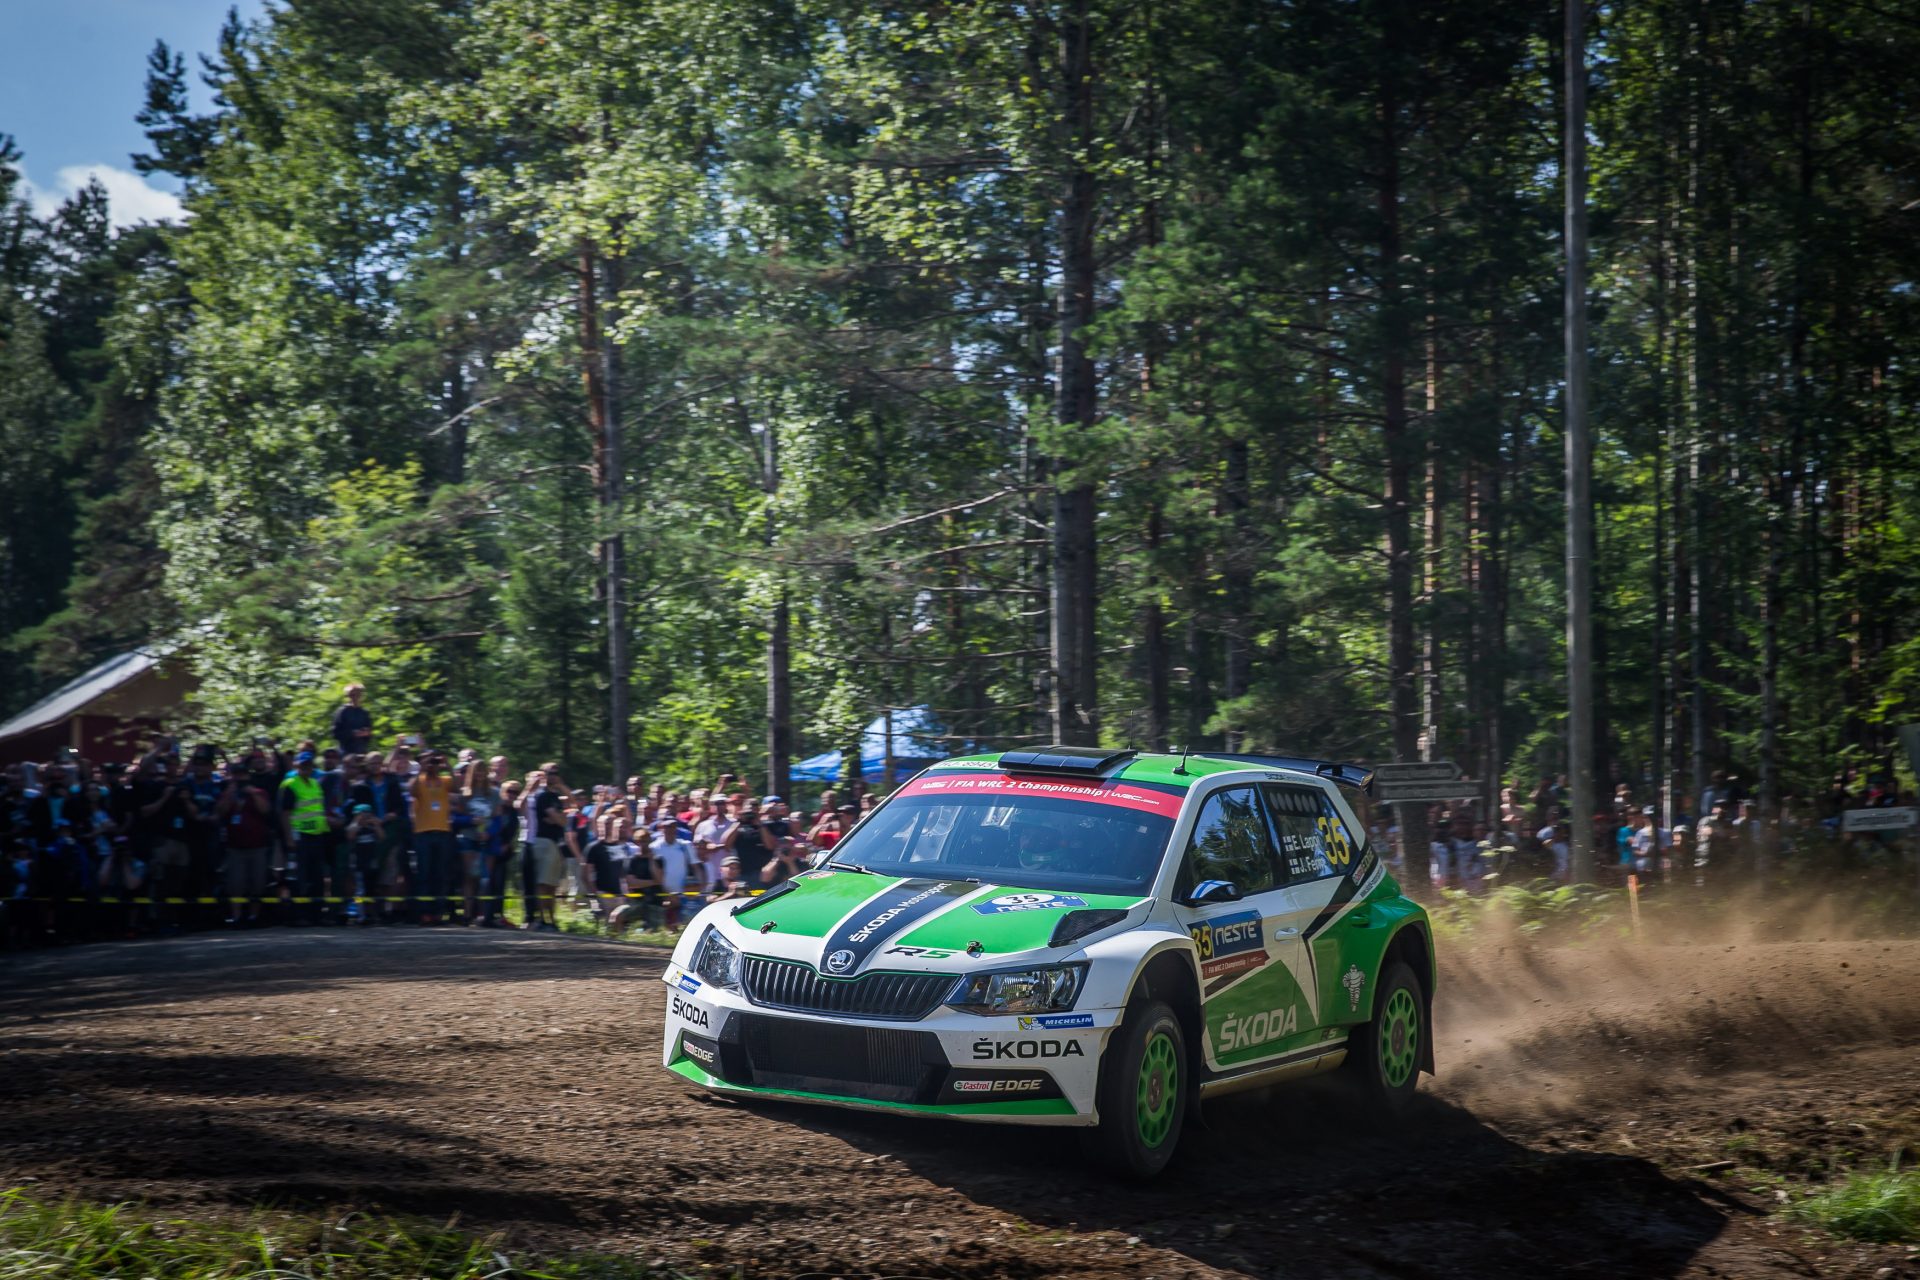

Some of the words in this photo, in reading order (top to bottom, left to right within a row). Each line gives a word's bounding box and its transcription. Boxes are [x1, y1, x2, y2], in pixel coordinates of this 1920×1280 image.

[954, 780, 974, 788] FIA
[977, 780, 1005, 788] WRC
[1017, 782, 1103, 797] Championship
[1318, 816, 1350, 865] 35
[995, 901, 1068, 912] NESTE
[1005, 894, 1040, 904] 35
[847, 907, 905, 943] ŠKODA
[1192, 925, 1213, 958] 35
[1215, 920, 1258, 946] NESTE
[884, 946, 959, 959] R5
[672, 993, 709, 1029] ŠKODA
[1045, 1016, 1092, 1026] MICHELIN
[1218, 1004, 1297, 1053] ŠKODA
[694, 1046, 714, 1063] EDGE
[972, 1037, 1085, 1060] ŠKODA
[963, 1081, 991, 1092] Castrol
[992, 1079, 1044, 1092] EDGE
